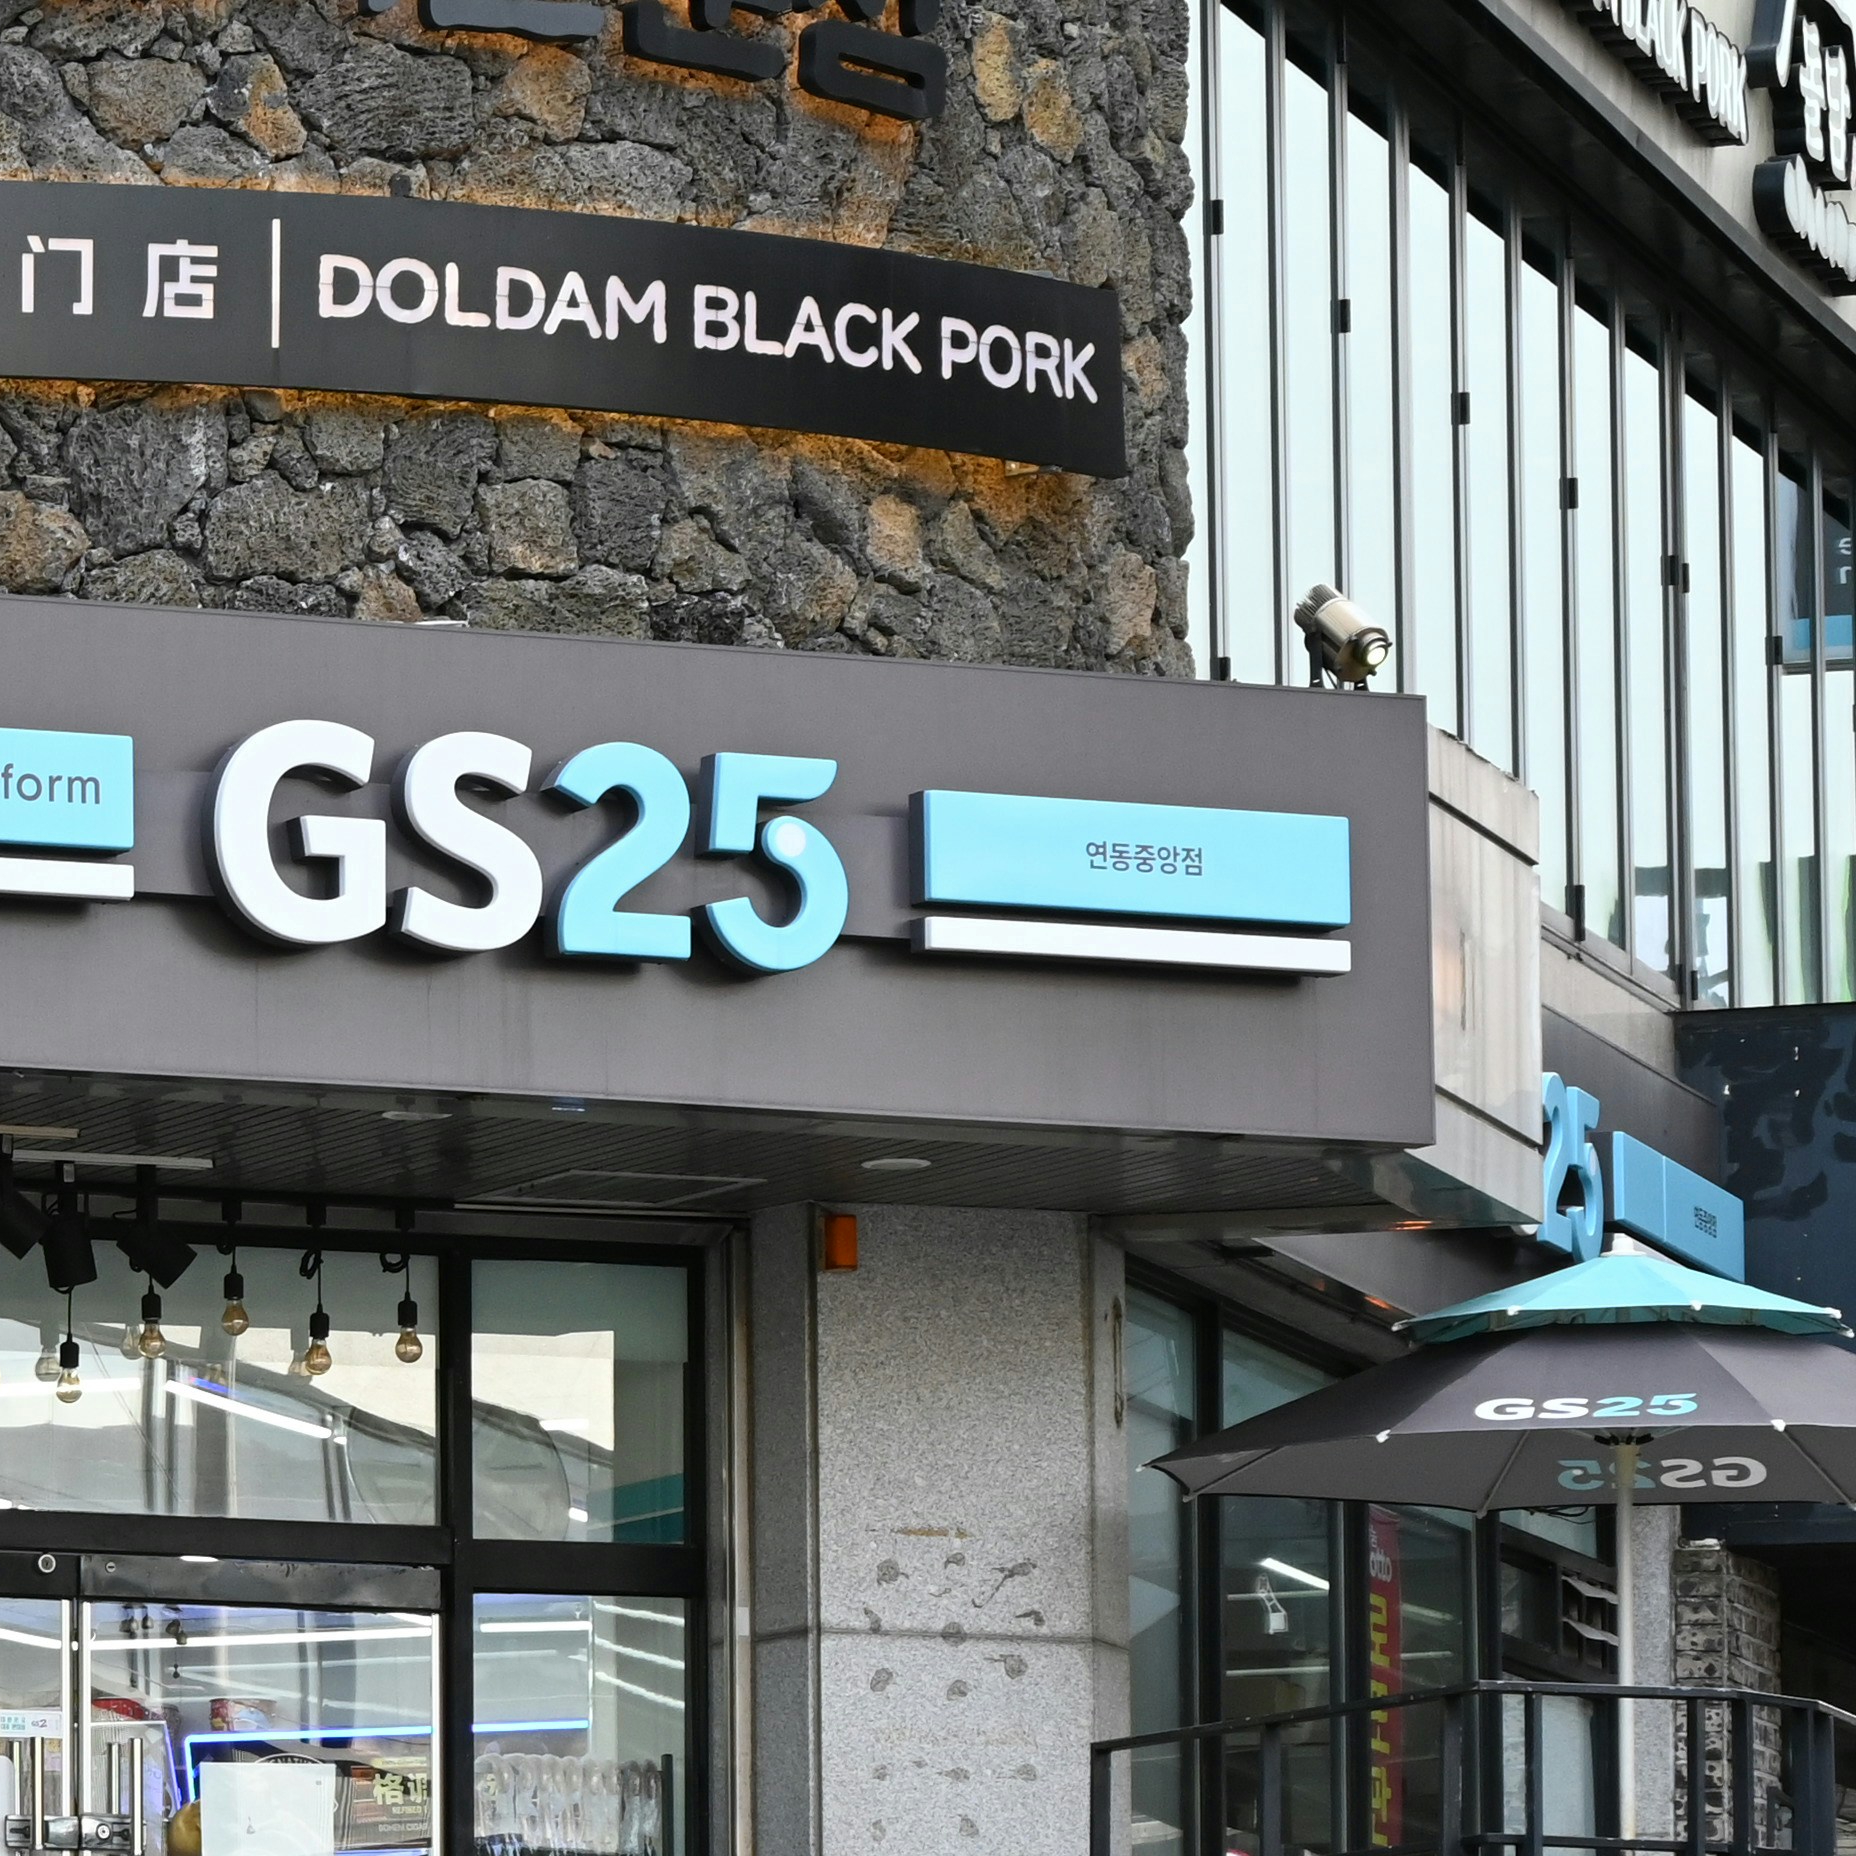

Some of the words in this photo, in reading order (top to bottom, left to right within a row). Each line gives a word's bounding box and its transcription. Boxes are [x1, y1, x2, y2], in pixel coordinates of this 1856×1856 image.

[1691, 8, 1748, 146] PORK
[318, 254, 668, 343] DOLDAM
[693, 285, 922, 375] BLACK
[940, 315, 1099, 405] PORK
[214, 718, 849, 973] GS25
[1084, 840, 1203, 878] 연동중앙점
[1474, 1393, 1698, 1421] GS25
